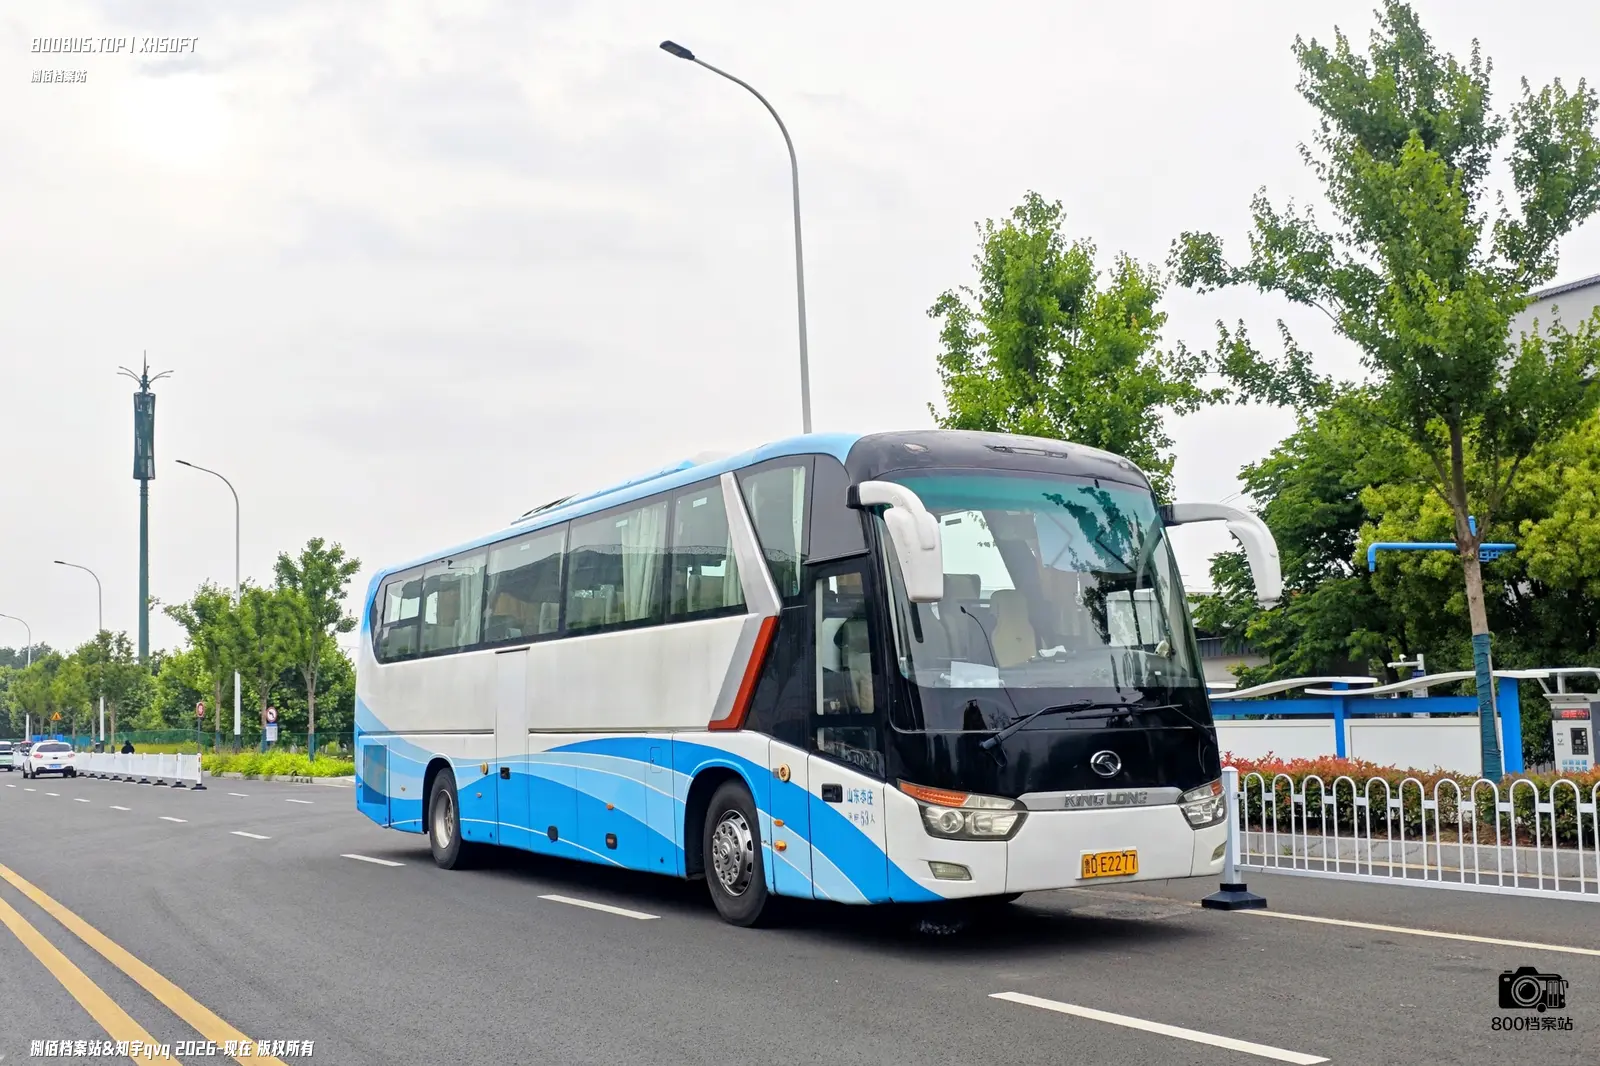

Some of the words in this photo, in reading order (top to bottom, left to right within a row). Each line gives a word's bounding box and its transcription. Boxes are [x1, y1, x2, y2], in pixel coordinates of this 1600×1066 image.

[847, 788, 873, 805] 山东枣庄
[1064, 792, 1105, 808] KING
